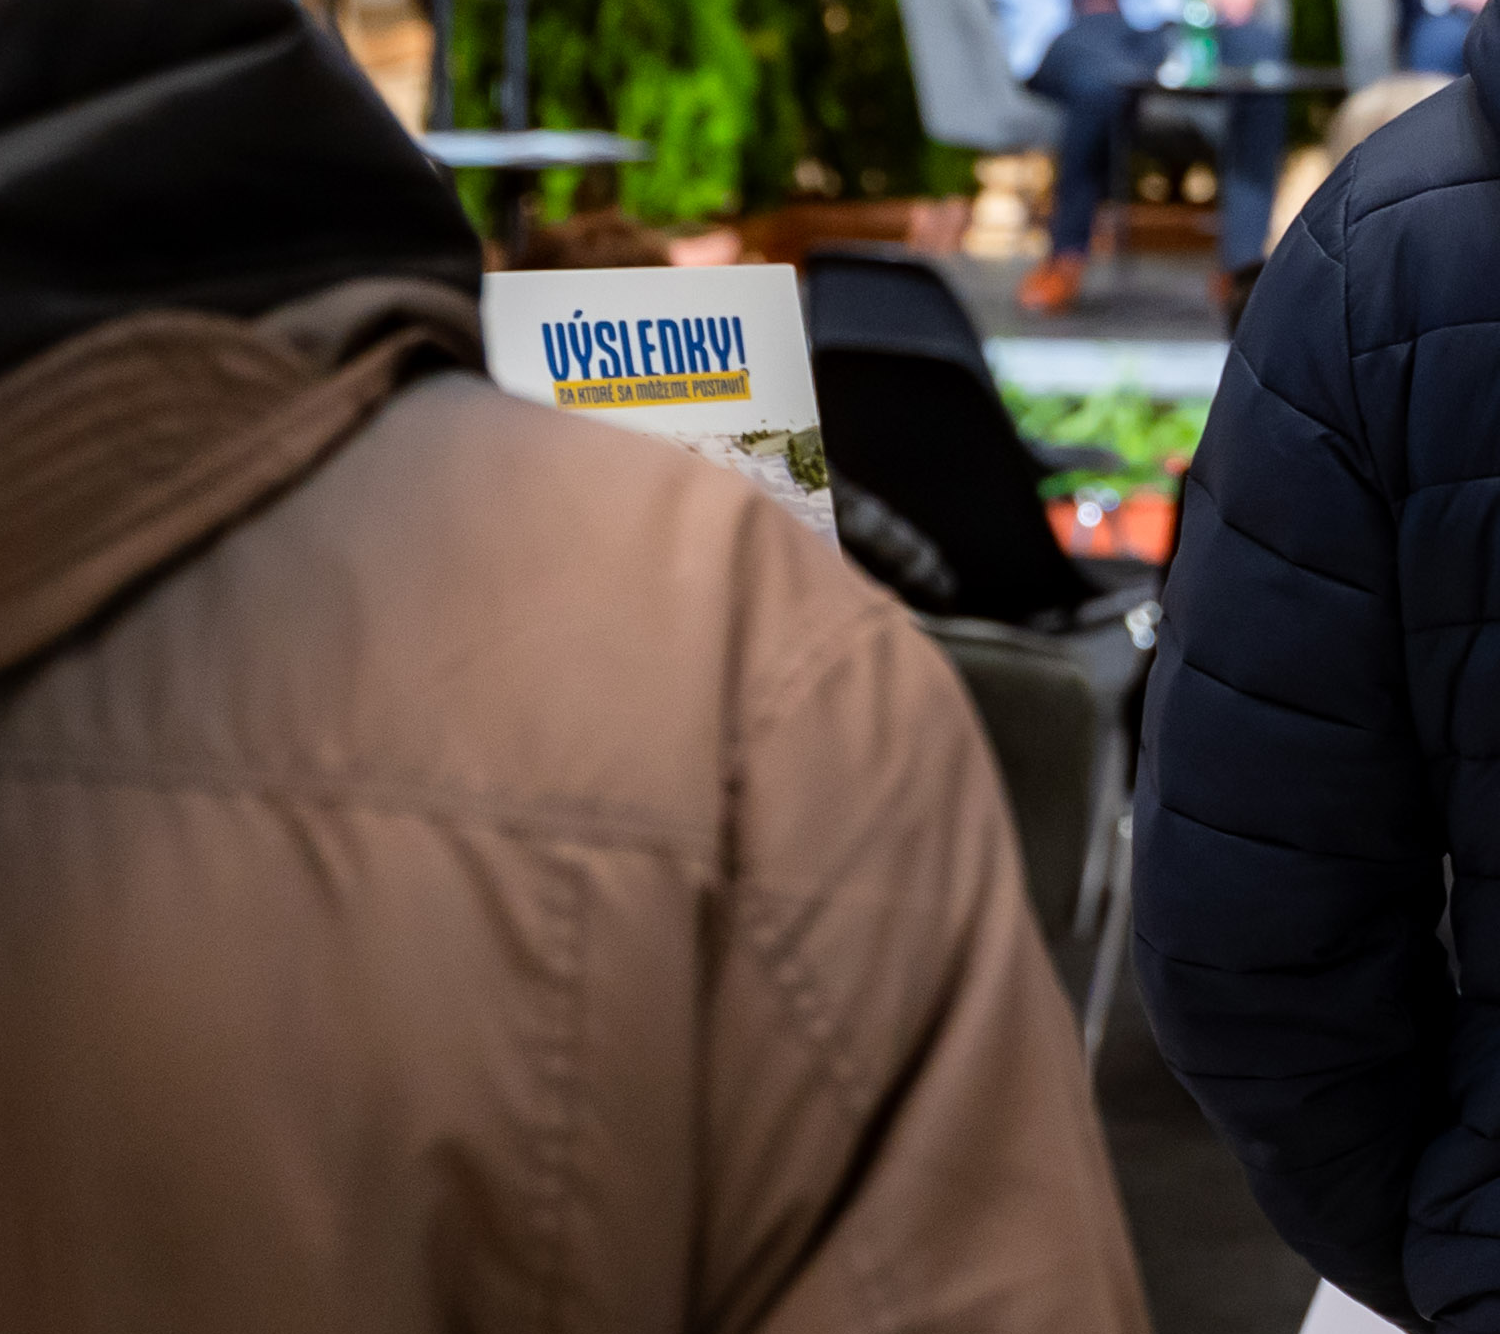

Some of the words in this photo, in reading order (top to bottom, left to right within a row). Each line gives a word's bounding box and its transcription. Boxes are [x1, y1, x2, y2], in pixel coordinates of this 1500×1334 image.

[542, 309, 749, 382] VÝSLEDKY!
[559, 387, 576, 405] ZA
[578, 384, 615, 404] KTORÉ
[618, 385, 634, 402] SA
[636, 380, 690, 401] MÔŽEME
